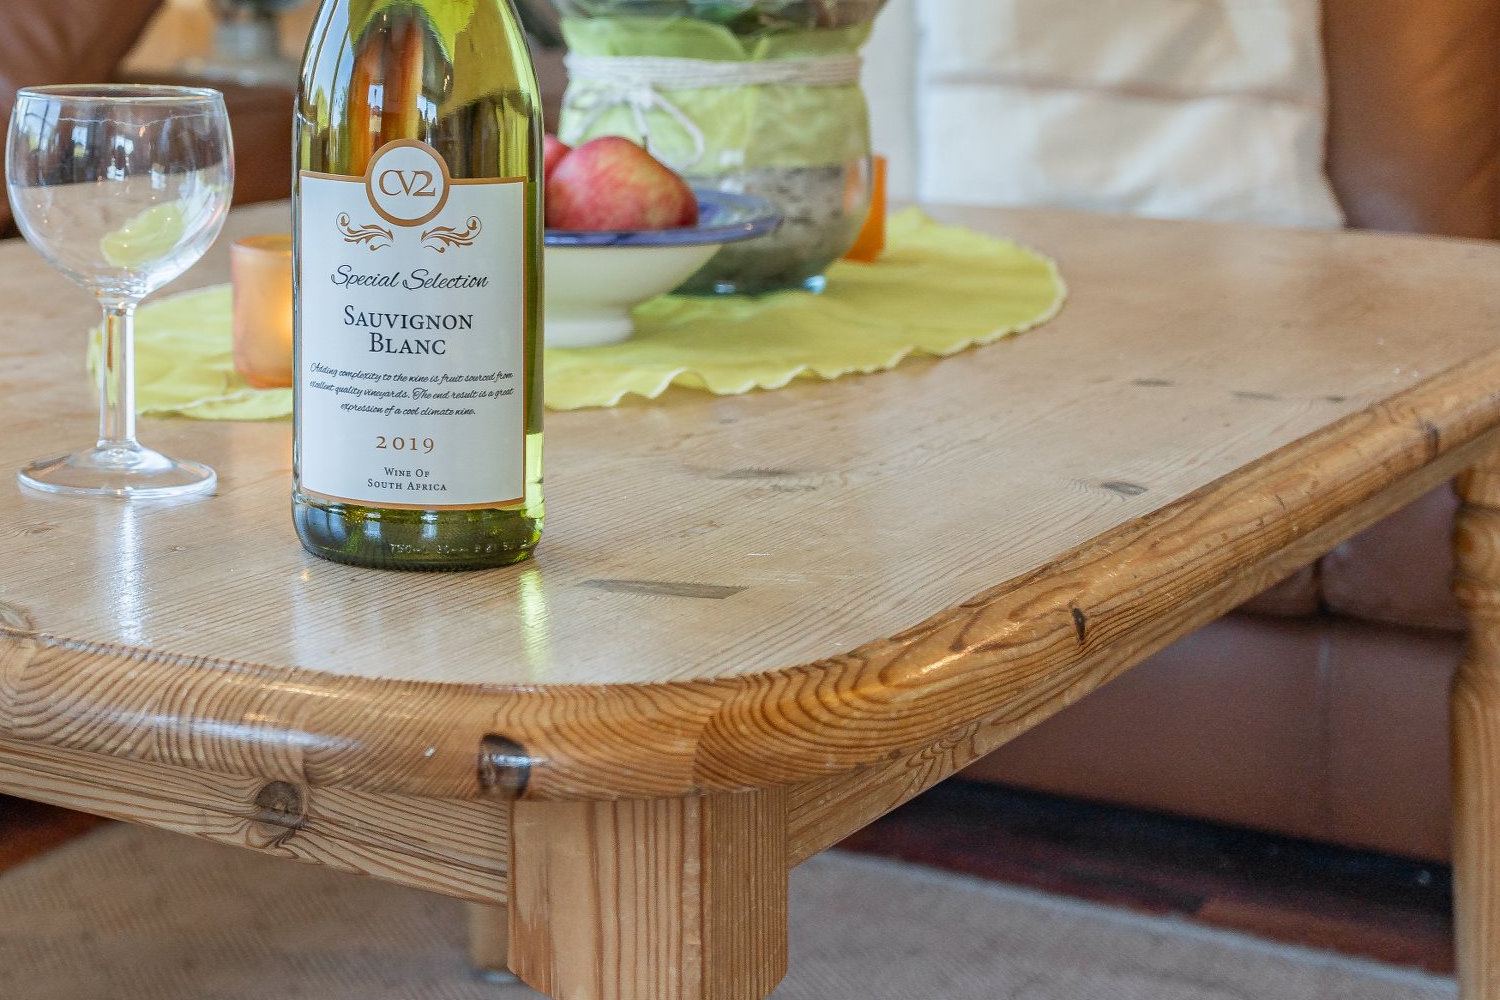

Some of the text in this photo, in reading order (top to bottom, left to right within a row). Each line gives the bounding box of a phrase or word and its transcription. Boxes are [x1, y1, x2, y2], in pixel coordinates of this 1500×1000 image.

[379, 169, 436, 197] CV2
[330, 264, 489, 291] Special Selection
[309, 362, 514, 385] Adding complexity to the wine is fruit sourced from
[309, 380, 335, 392] excellent
[335, 385, 363, 397] quality
[363, 388, 411, 399] vineyards.
[412, 387, 431, 401] The
[432, 390, 451, 399] end
[451, 389, 479, 399] result
[478, 390, 488, 399] is
[493, 387, 515, 399] great
[340, 402, 384, 414] expression
[384, 405, 395, 417] of
[402, 406, 420, 415] cool
[420, 407, 454, 416] climate
[375, 435, 435, 454] 2019
